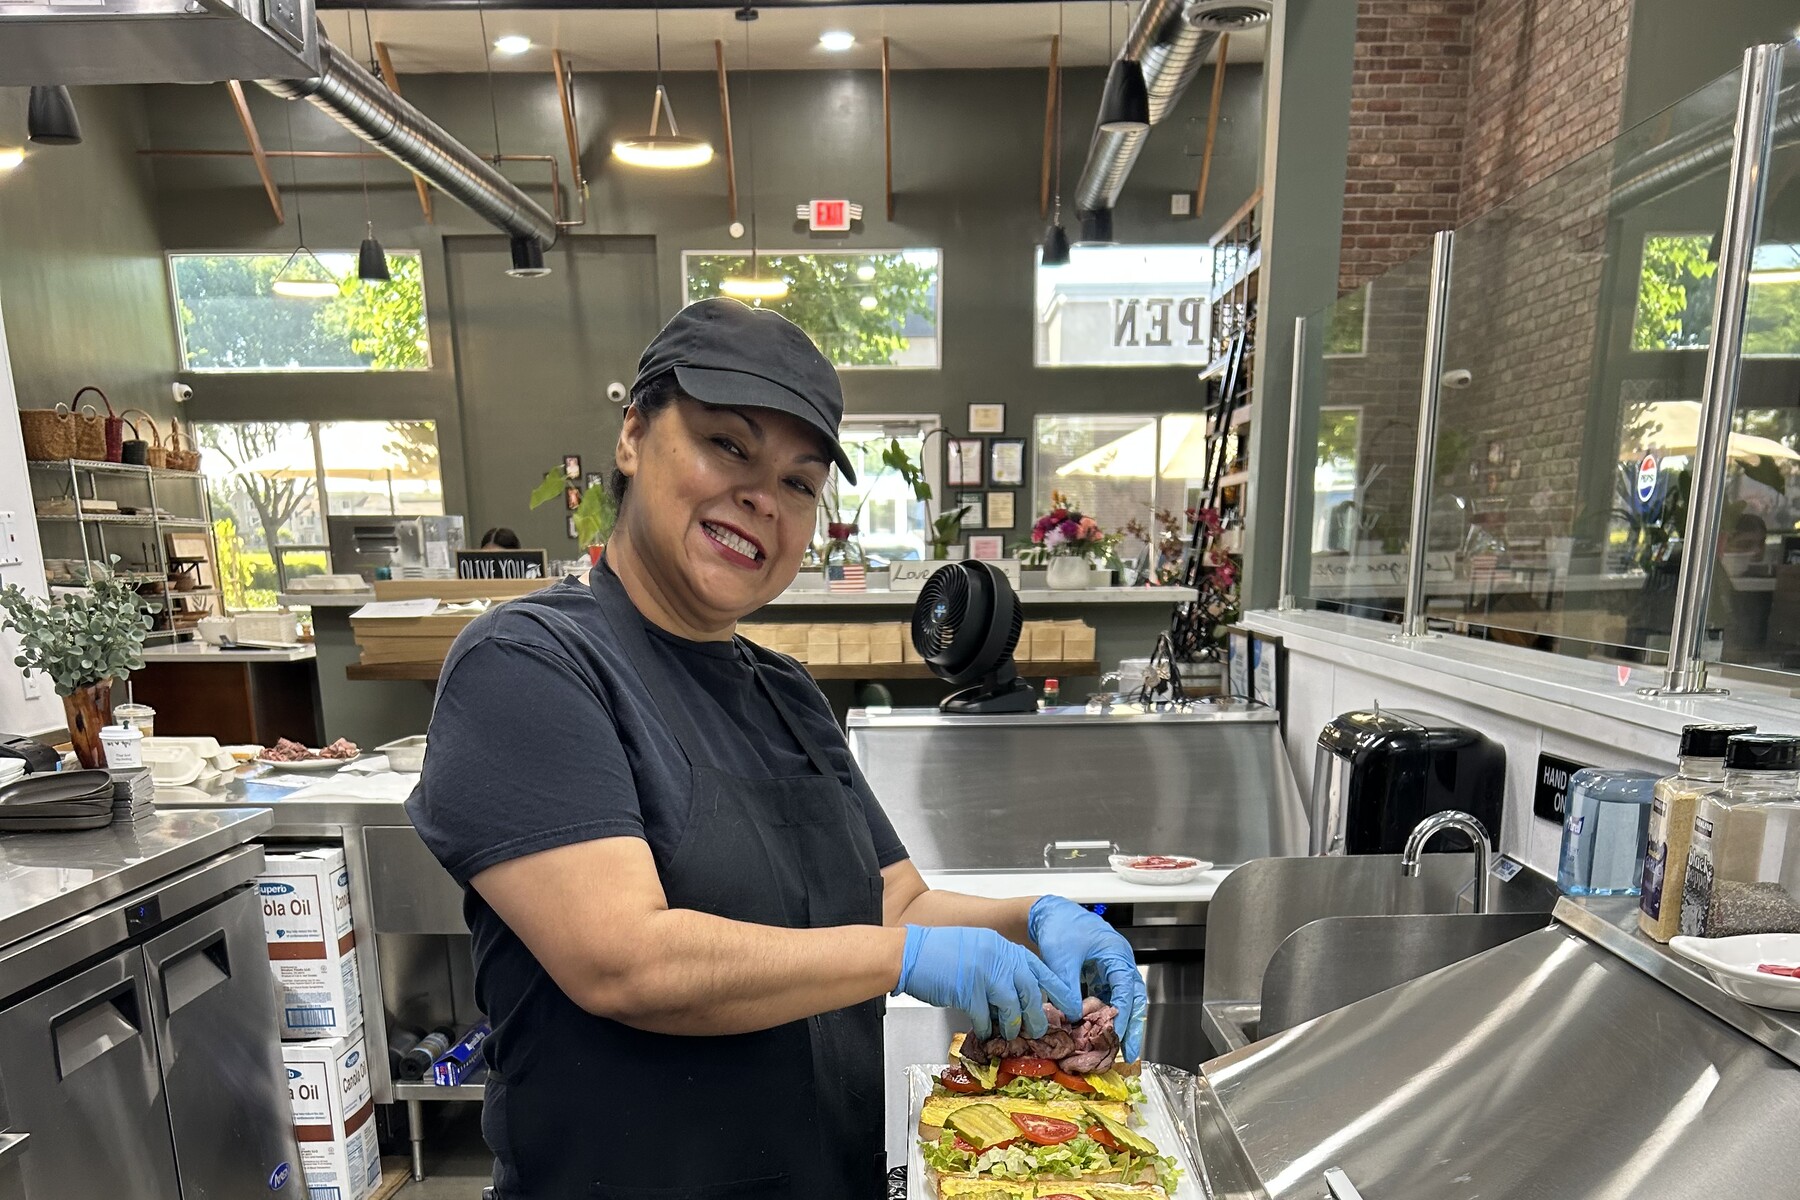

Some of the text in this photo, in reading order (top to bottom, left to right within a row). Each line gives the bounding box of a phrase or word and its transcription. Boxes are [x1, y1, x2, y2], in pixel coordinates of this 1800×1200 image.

[817, 202, 844, 226] EXIT
[1543, 765, 1567, 791] HAND
[259, 884, 287, 896] uperb
[263, 899, 311, 916] ola Oil
[298, 1084, 319, 1101] Oil
